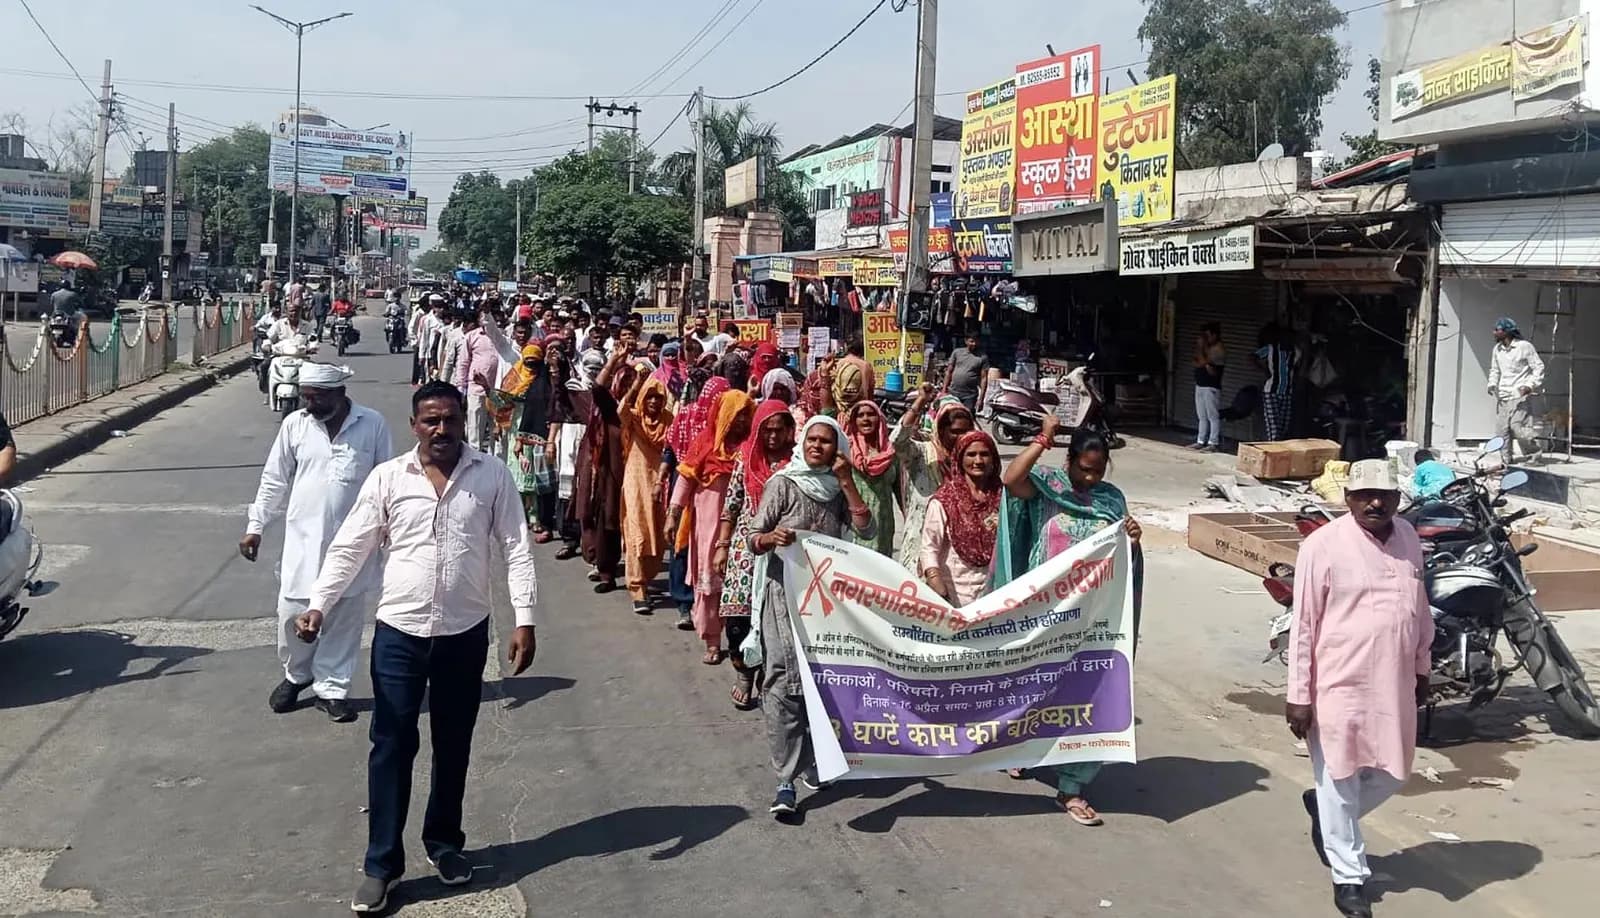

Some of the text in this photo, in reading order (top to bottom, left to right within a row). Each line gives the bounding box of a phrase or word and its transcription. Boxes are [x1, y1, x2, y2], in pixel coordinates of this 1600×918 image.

[964, 115, 1012, 157] असीजा
[1020, 95, 1096, 149] आस्था
[1103, 100, 1170, 172] टुटेजा
[376, 135, 394, 146] SCHOOL
[962, 155, 987, 184] पुस्तक
[988, 149, 1013, 170] भण्डार
[1020, 158, 1062, 196] स्कूल
[1120, 152, 1169, 185] किताब घर
[954, 222, 986, 271] टुटेजा
[984, 224, 1011, 258] किताब
[1123, 245, 1145, 270] ग्रोवर
[868, 338, 899, 355] स्कूल
[830, 571, 950, 627] नगरपालिका
[971, 618, 1018, 639] कर्मचारी
[1017, 614, 1039, 631] संघ
[1038, 608, 1081, 628] हरियाणा
[998, 678, 1012, 690] के
[1082, 657, 1115, 672] द्वारा
[915, 700, 940, 713] अप्रैल
[998, 696, 1005, 706] 8
[1006, 694, 1017, 706] से
[906, 722, 958, 747] काम
[964, 720, 1001, 745] का
[1006, 703, 1094, 736] बहिष्कार
